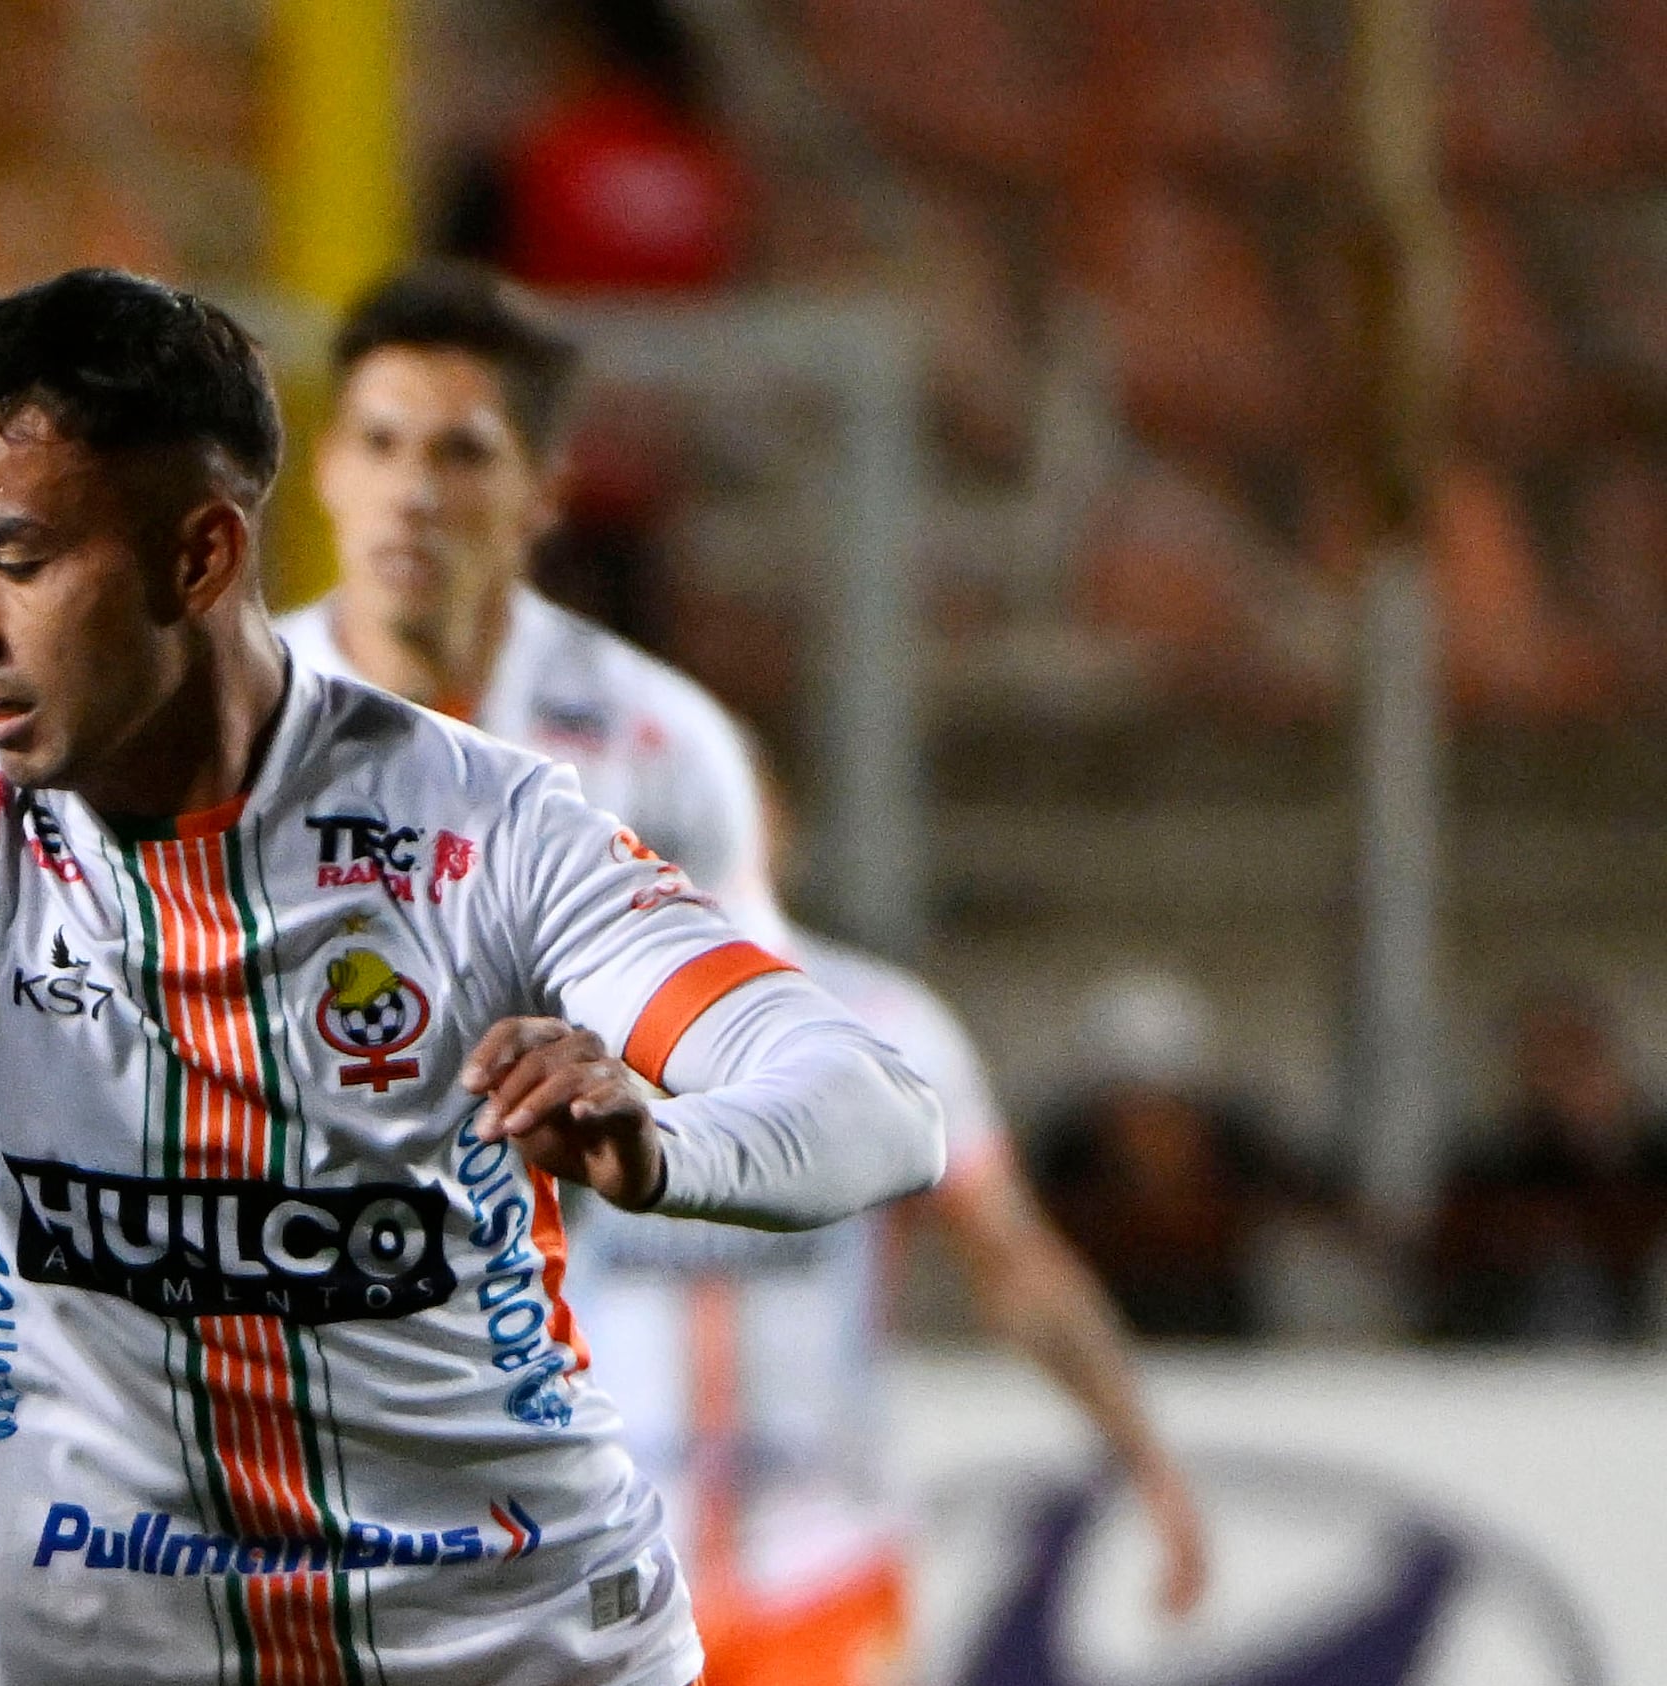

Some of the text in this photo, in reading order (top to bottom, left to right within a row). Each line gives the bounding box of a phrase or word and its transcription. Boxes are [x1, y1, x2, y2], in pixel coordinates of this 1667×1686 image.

[13, 966, 115, 1021] KS7
[20, 1173, 427, 1279] HUILCO
[457, 1117, 559, 1372] RODASTO
[45, 1245, 435, 1313] AIMNTOS
